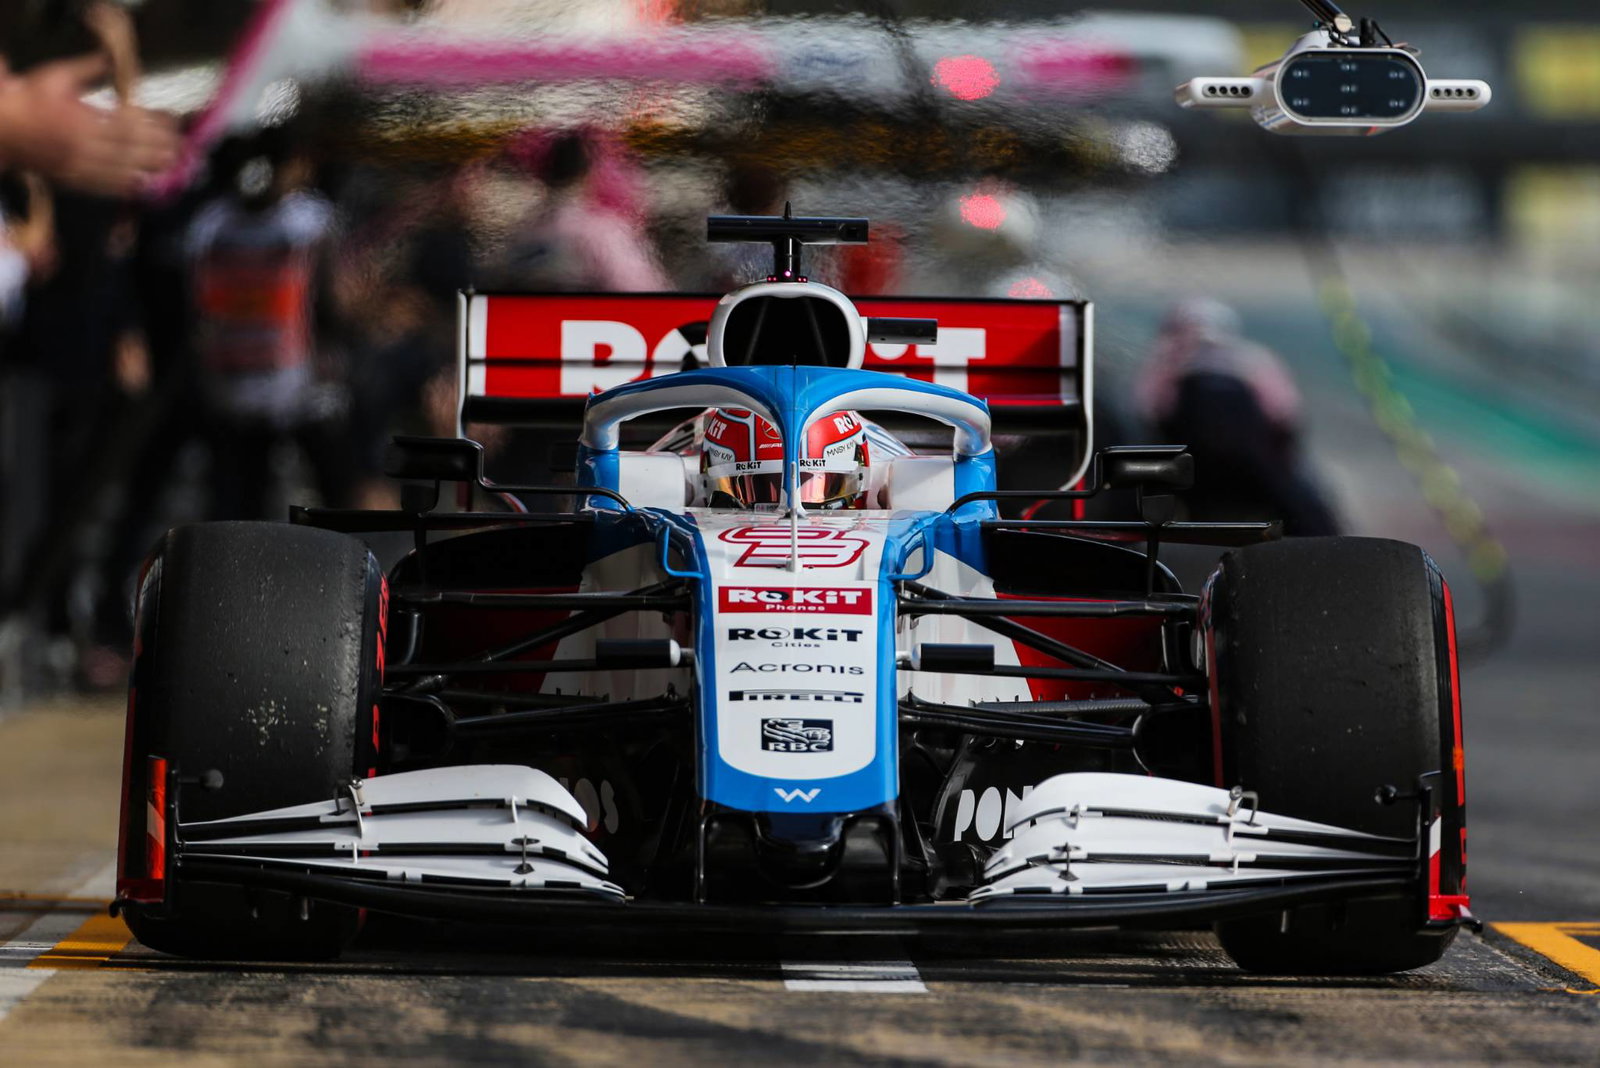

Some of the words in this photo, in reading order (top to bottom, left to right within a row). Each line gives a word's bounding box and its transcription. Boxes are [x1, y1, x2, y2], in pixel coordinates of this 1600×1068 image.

[765, 604, 826, 612] Phones
[729, 661, 865, 676] Acronis
[728, 688, 866, 704] PIRELLI
[768, 741, 829, 752] RBC
